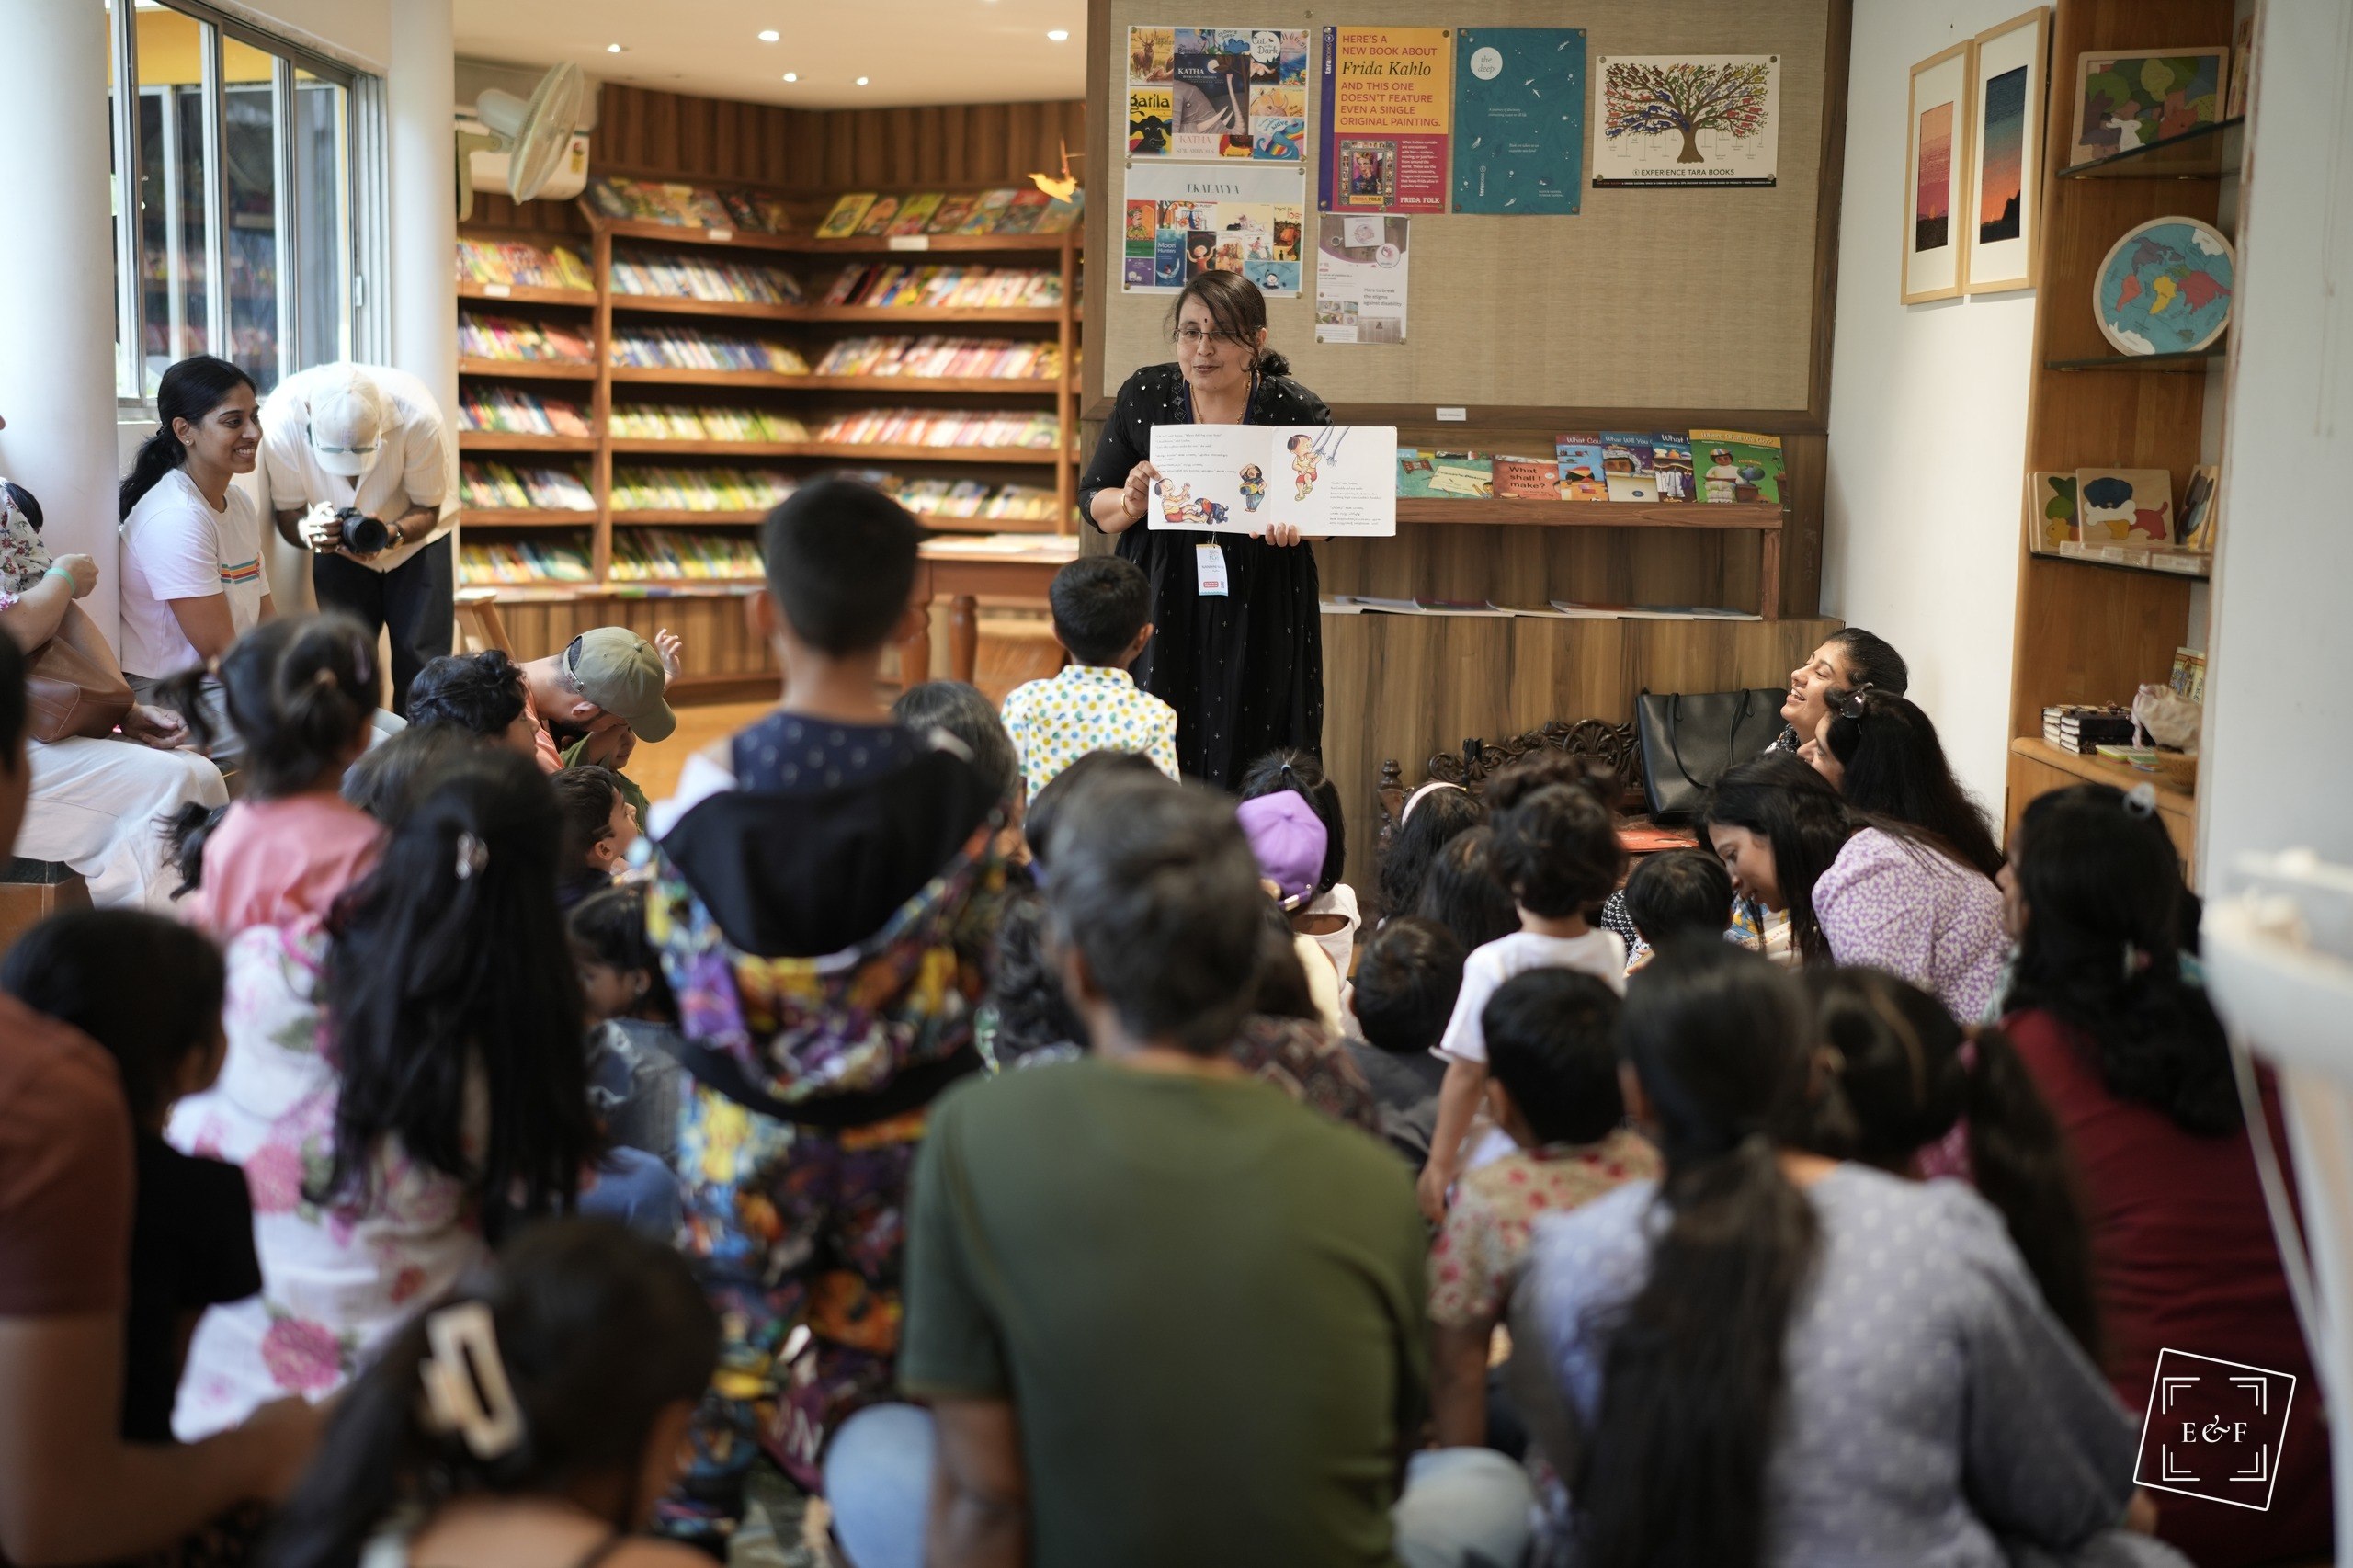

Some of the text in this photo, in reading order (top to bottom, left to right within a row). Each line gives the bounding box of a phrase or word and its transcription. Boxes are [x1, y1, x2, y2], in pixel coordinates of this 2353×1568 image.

[1342, 35, 1377, 43] HERE'S
[1257, 46, 1278, 54] Dark
[1342, 47, 1366, 55] NEW
[1402, 48, 1438, 56] ABOUT
[1482, 55, 1492, 63] the
[1342, 62, 1431, 75] Frida Kahlo
[1478, 64, 1495, 74] deep
[1341, 94, 1433, 103] DOESN'T FEATURE
[1370, 106, 1377, 114] A
[1380, 106, 1415, 114] SINGLE
[1662, 435, 1683, 443] What
